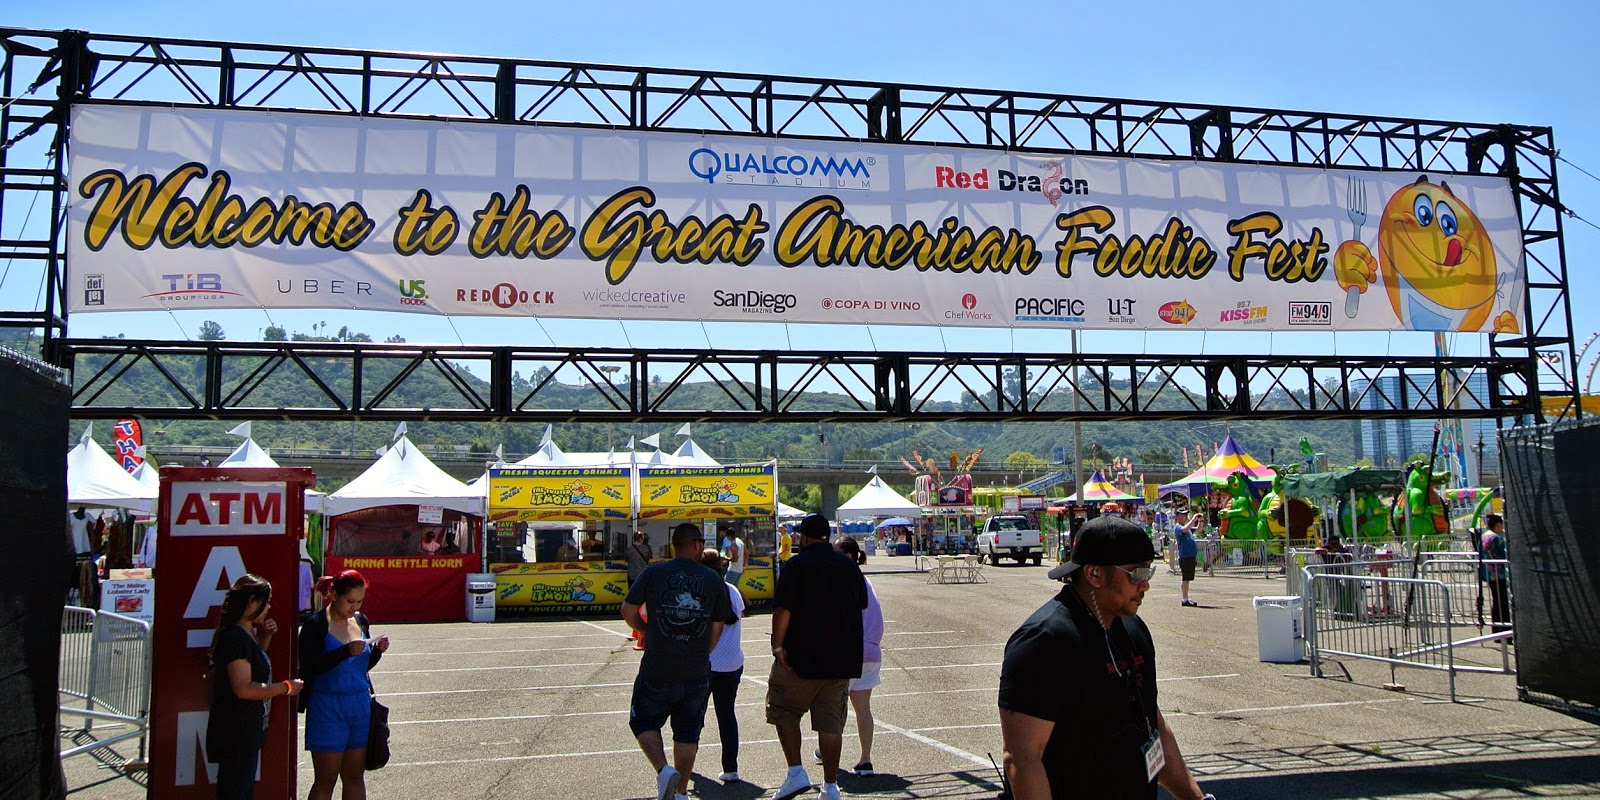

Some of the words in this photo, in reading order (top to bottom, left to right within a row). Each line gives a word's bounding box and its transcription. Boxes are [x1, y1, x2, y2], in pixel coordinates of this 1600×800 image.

[689, 148, 870, 183] QUALCOMM
[725, 174, 871, 188] STADIUM
[936, 166, 988, 190] Red
[79, 161, 375, 251] Welcome
[394, 189, 459, 256] to
[468, 184, 575, 260] the
[579, 186, 768, 285] Great
[774, 195, 1042, 275] American
[1055, 205, 1217, 279] Foodie
[1227, 210, 1331, 283] Fest
[277, 279, 372, 296] UBER
[400, 298, 427, 306] FOODS
[834, 300, 870, 310] COPA
[874, 301, 887, 310] DI
[891, 301, 921, 311] VINO
[1015, 297, 1086, 316] PACIFIC
[1120, 316, 1136, 324] Diego
[530, 494, 571, 506] LEMON
[679, 492, 718, 504] LEMON
[175, 492, 282, 525] ATM
[344, 559, 385, 569] MANNA
[388, 558, 429, 568] KETTLE
[431, 558, 463, 568] KORN
[531, 591, 572, 603] LEMON
